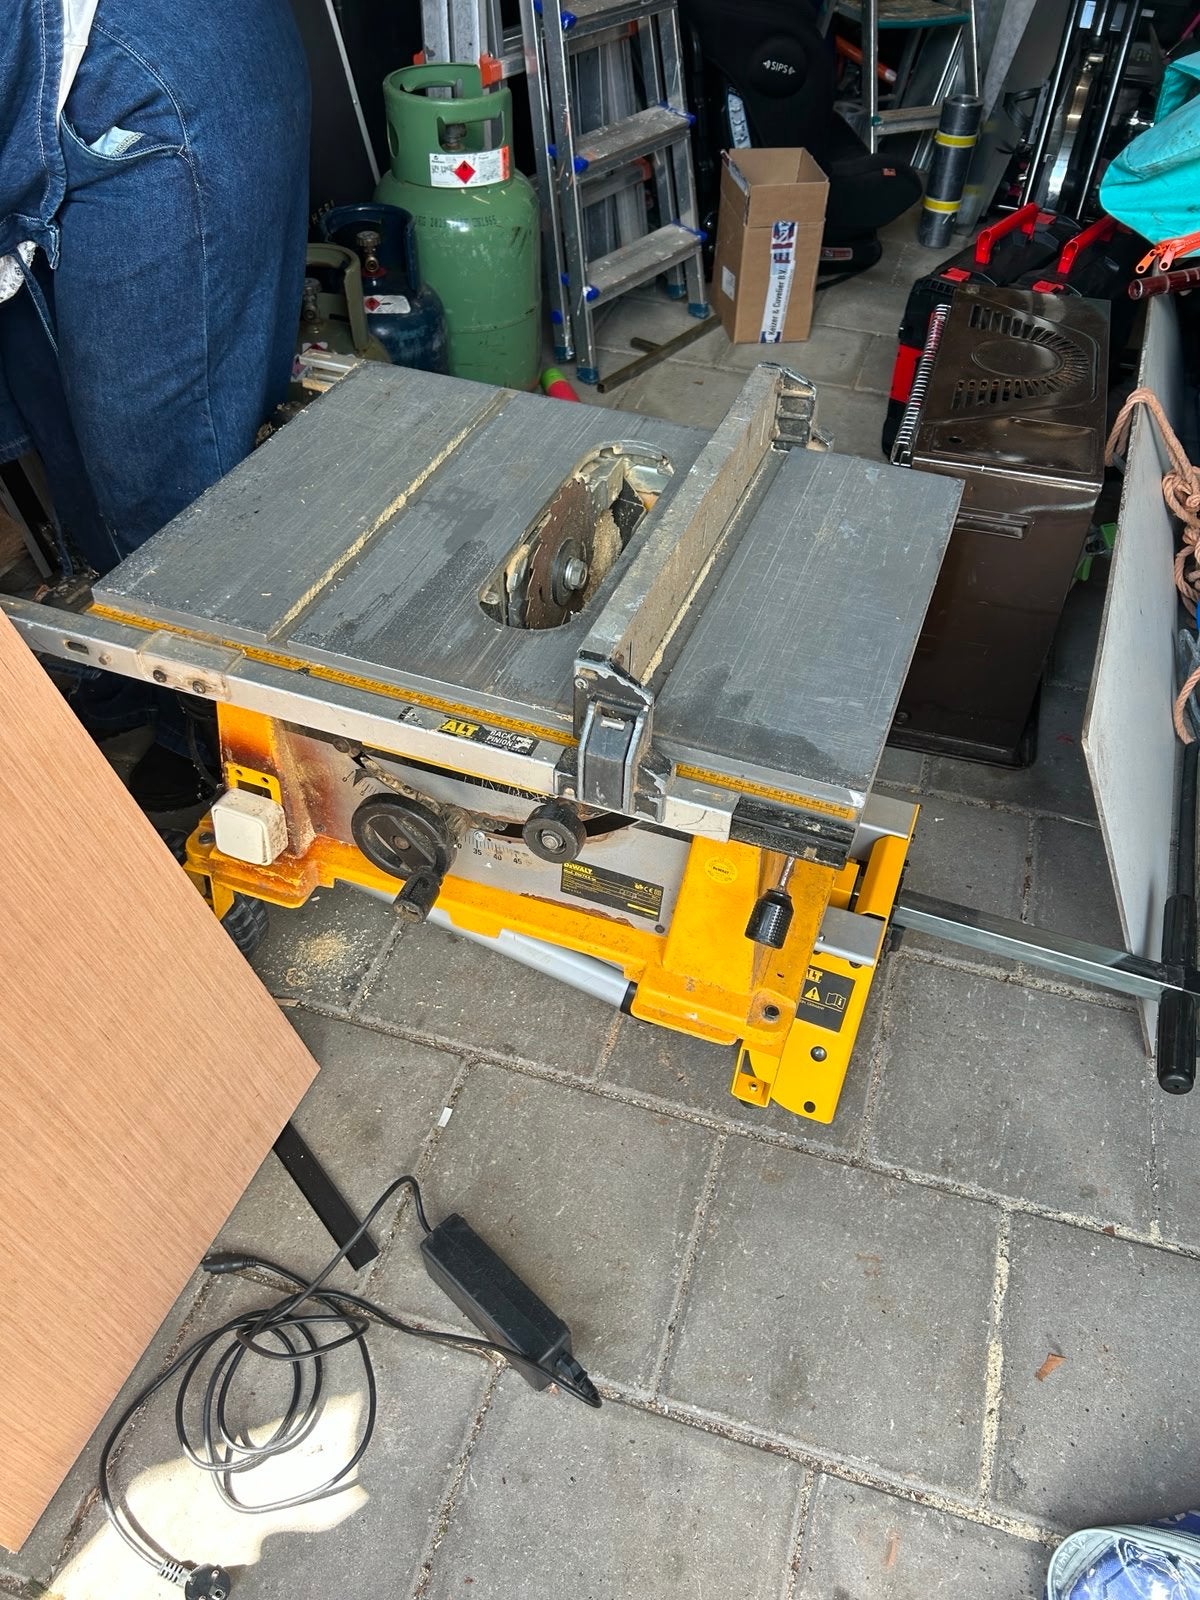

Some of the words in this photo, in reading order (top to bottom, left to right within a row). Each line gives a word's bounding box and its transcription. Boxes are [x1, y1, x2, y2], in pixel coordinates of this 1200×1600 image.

[771, 61, 789, 74] SIPS
[768, 315, 778, 336] Keizer
[773, 281, 785, 308] Cuvelier
[486, 736, 513, 747] PINION
[473, 848, 483, 856] 35
[493, 853, 503, 861] 40
[513, 857, 523, 865] 45
